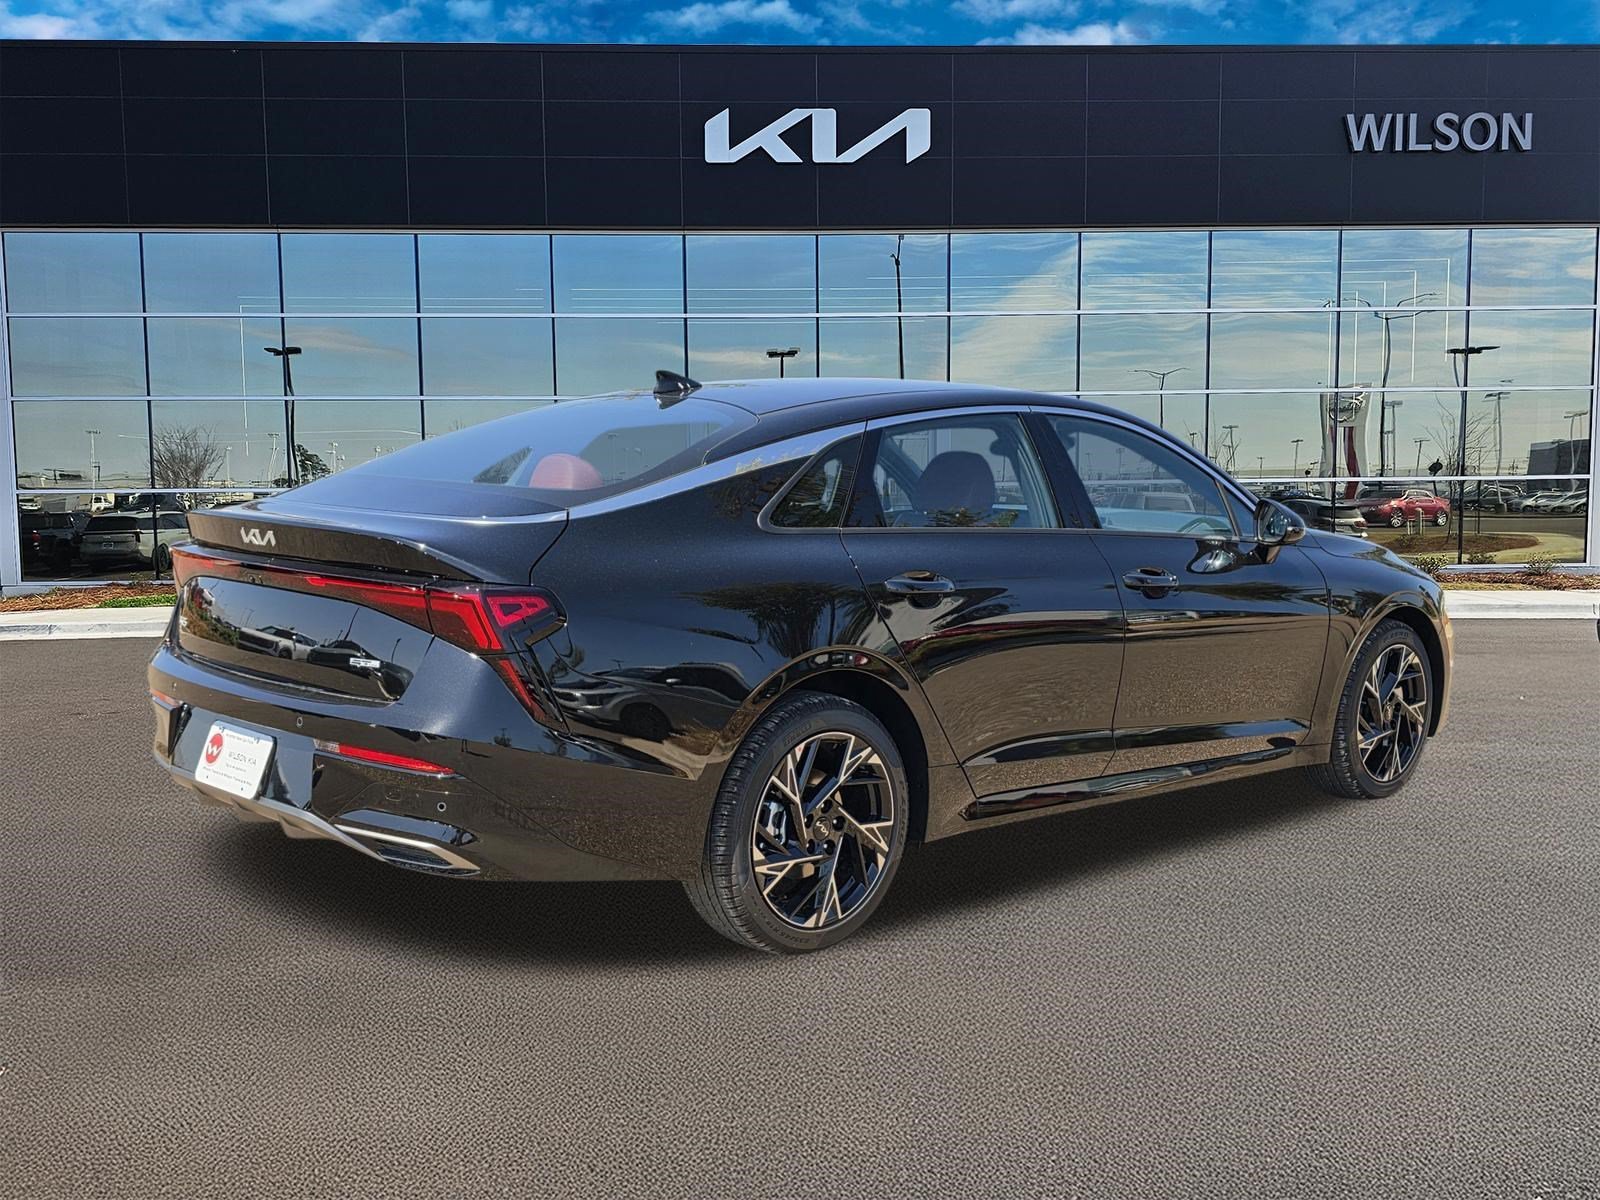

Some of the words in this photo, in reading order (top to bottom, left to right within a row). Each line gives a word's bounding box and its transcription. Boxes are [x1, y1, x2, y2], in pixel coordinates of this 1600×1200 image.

[704, 107, 931, 164] KIA
[1346, 112, 1533, 152] WILSON
[240, 526, 277, 547] KIA
